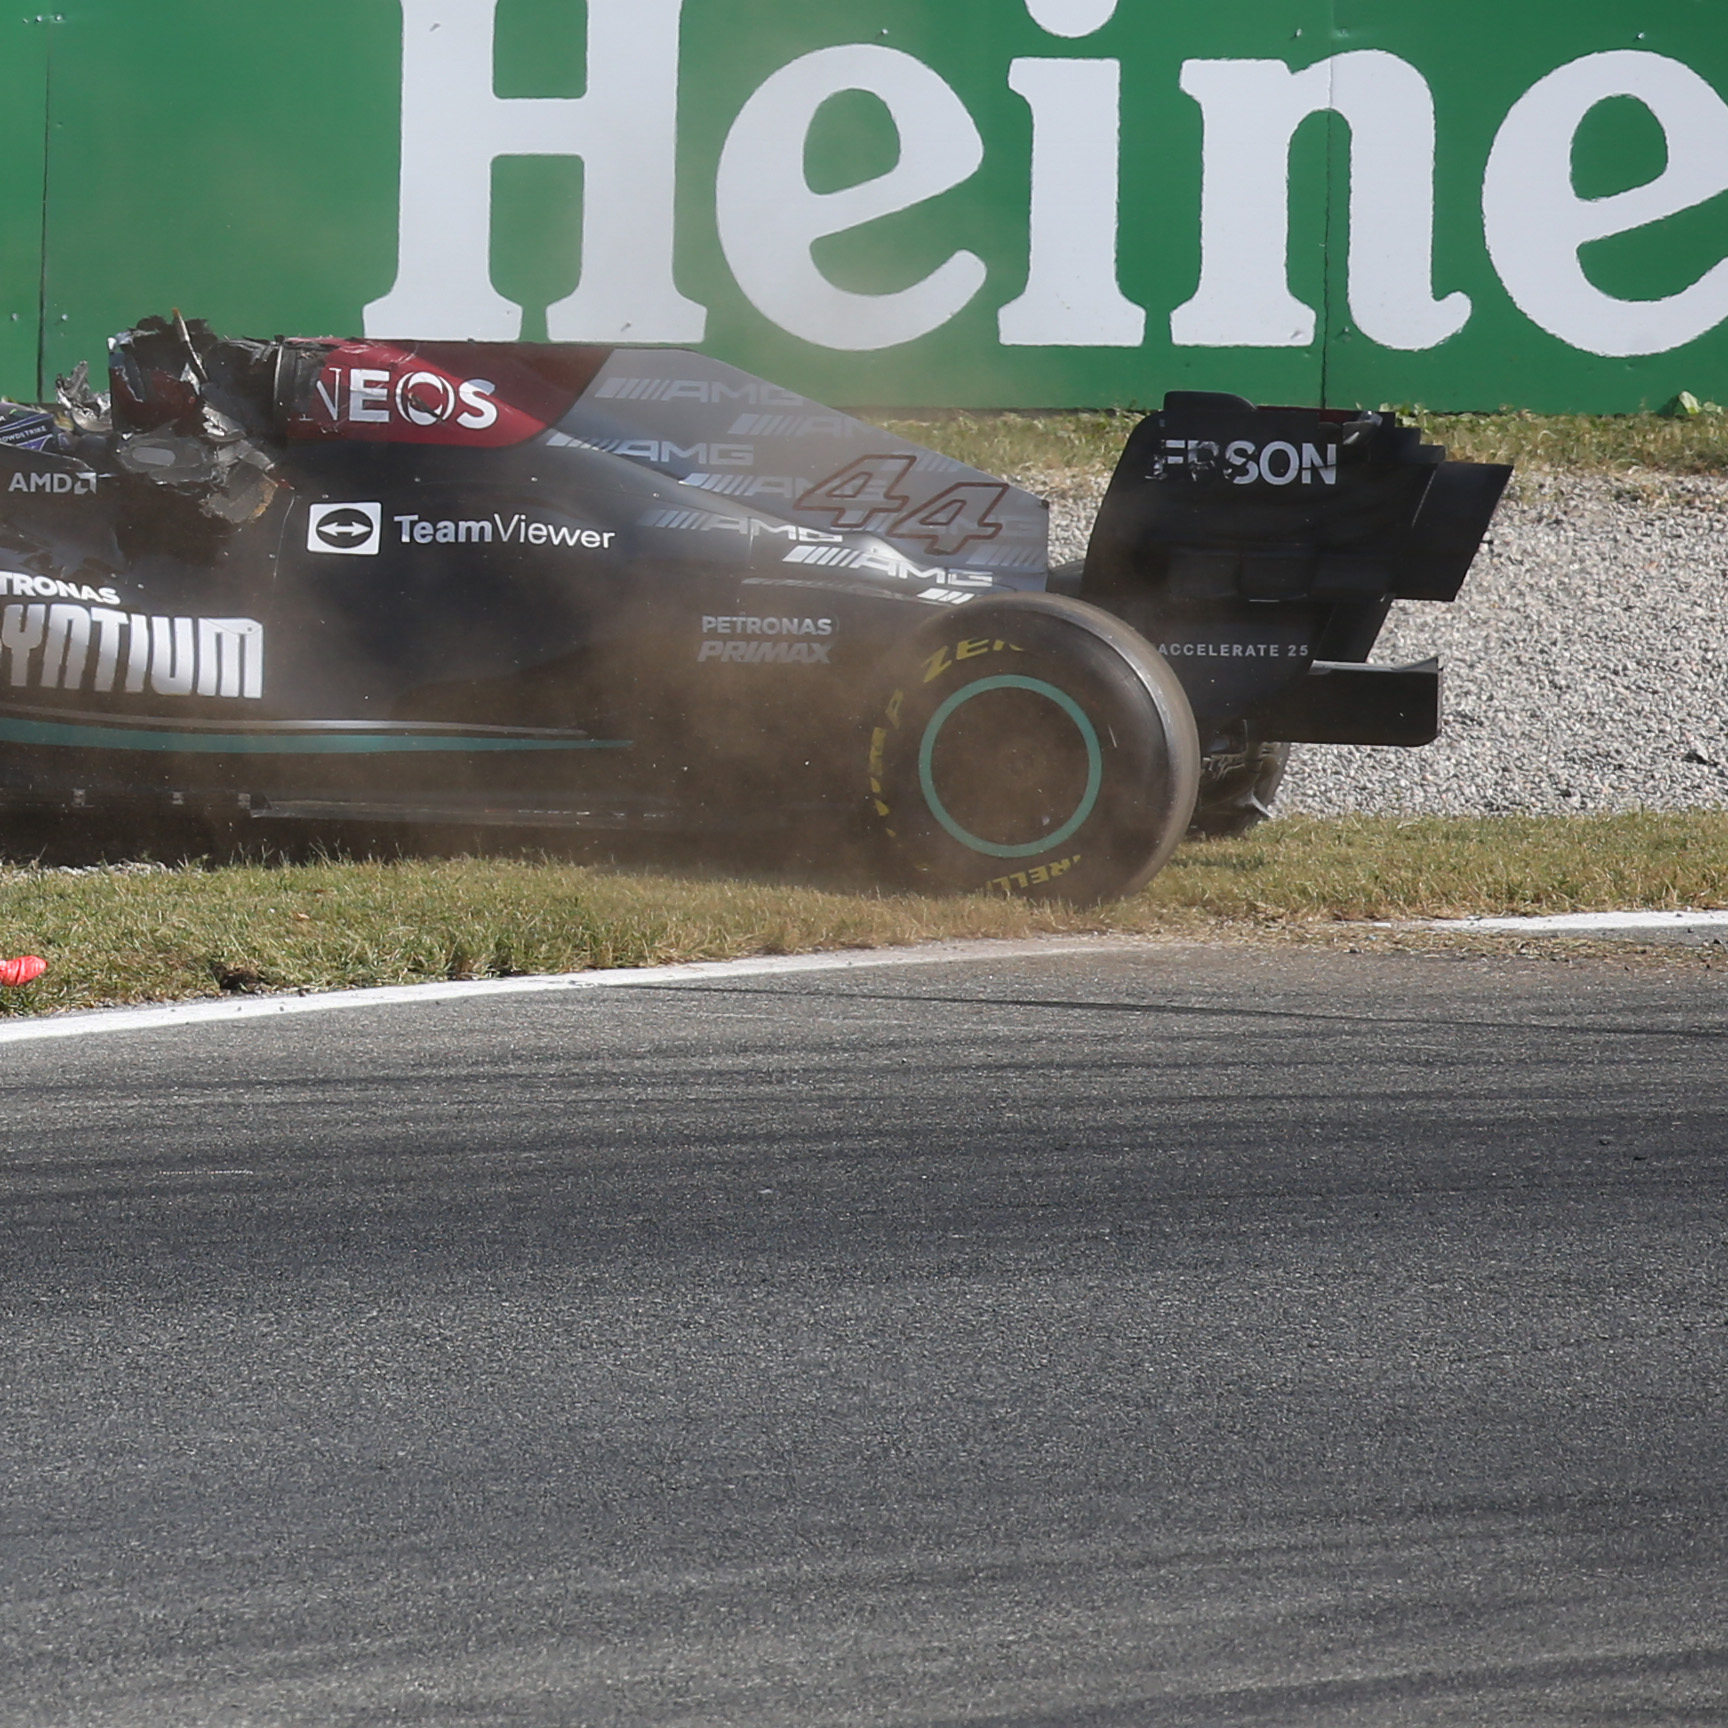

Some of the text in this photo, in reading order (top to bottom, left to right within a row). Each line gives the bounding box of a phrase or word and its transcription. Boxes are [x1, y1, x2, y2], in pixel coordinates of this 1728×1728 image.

[8, 472, 73, 493] AMD
[793, 454, 1009, 556] 44
[394, 512, 616, 550] TeamViewer
[702, 616, 833, 636] PETRONAS
[696, 640, 832, 665] PRIMAX
[1157, 643, 1309, 657] ACCELERATE 25
